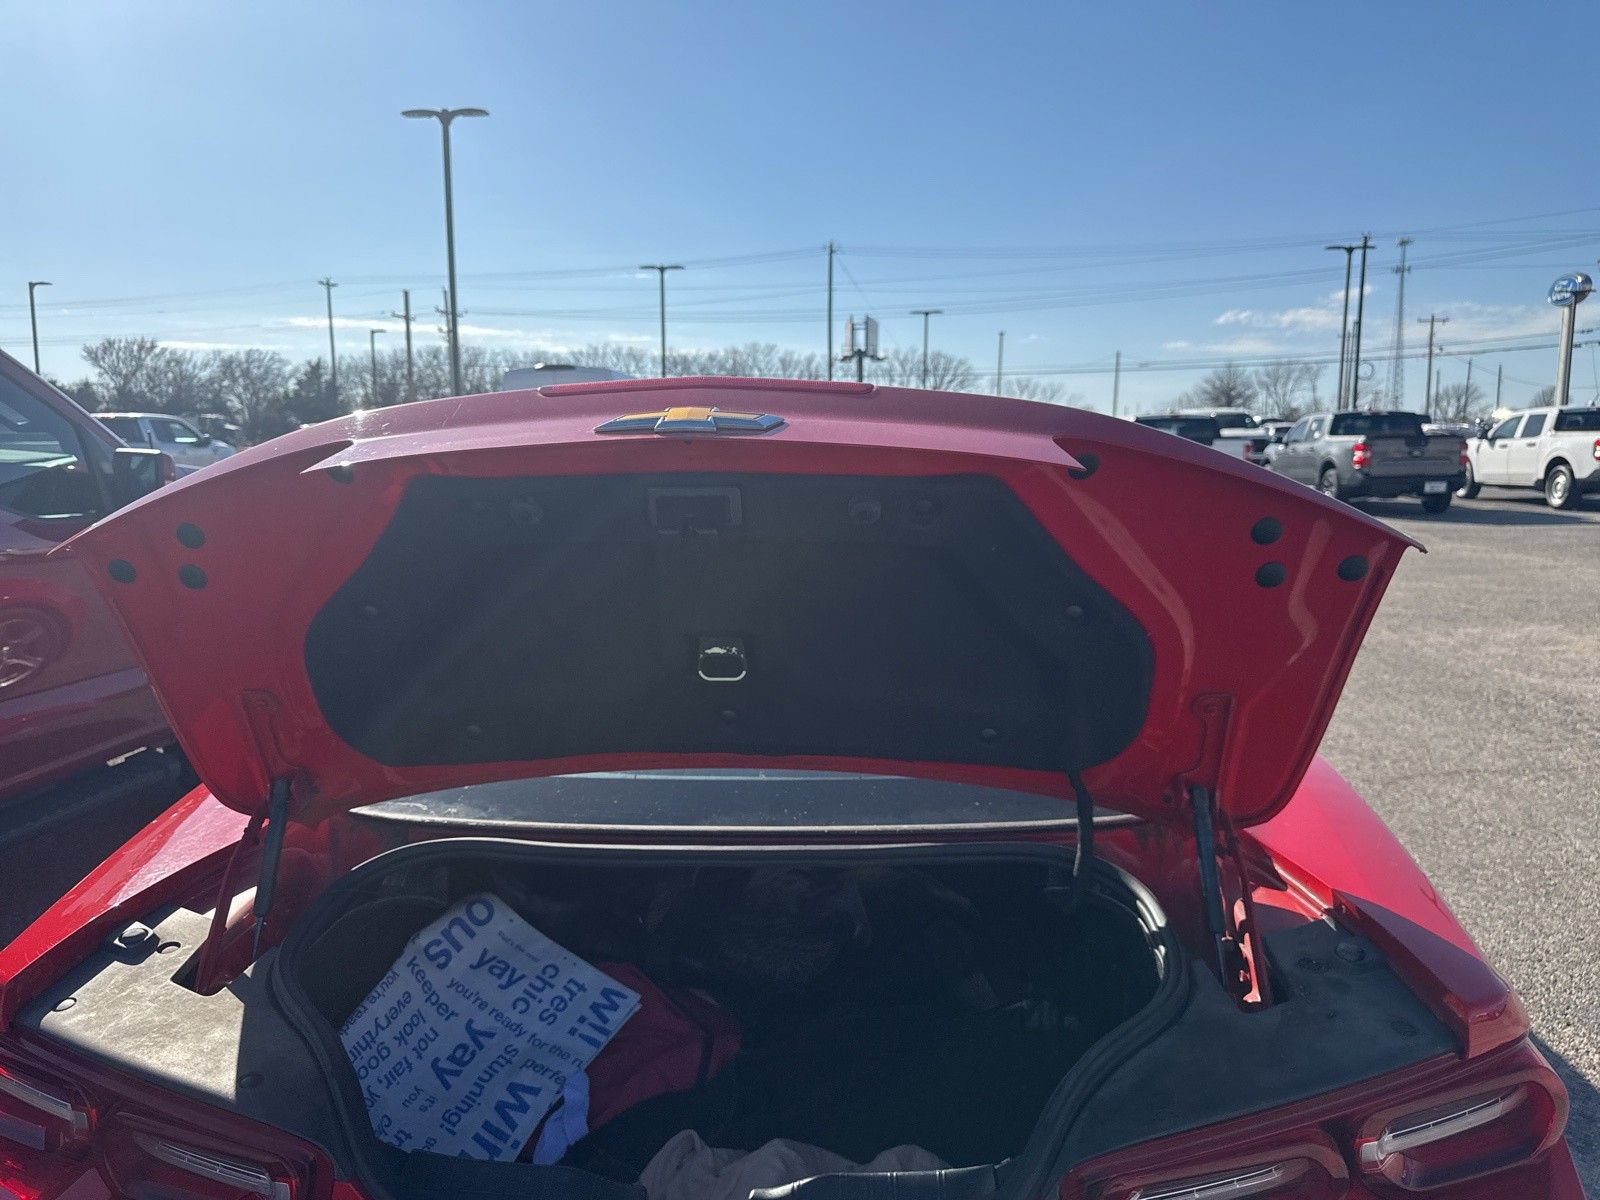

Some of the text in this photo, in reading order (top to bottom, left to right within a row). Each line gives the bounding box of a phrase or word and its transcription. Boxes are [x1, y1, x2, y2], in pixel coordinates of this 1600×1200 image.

[406, 955, 459, 1021] keeper
[469, 947, 527, 990] yay
[512, 963, 560, 1014] chic
[446, 978, 489, 1010] you're
[488, 1008, 528, 1037] ready
[527, 1032, 550, 1048] for
[548, 1044, 571, 1060] the
[538, 977, 588, 1026] tres
[393, 1008, 427, 1048] look
[411, 1027, 440, 1060] not
[377, 1056, 413, 1089] fair,
[431, 1018, 497, 1091] yay
[402, 1085, 425, 1108] you
[440, 1043, 519, 1136] stunning!
